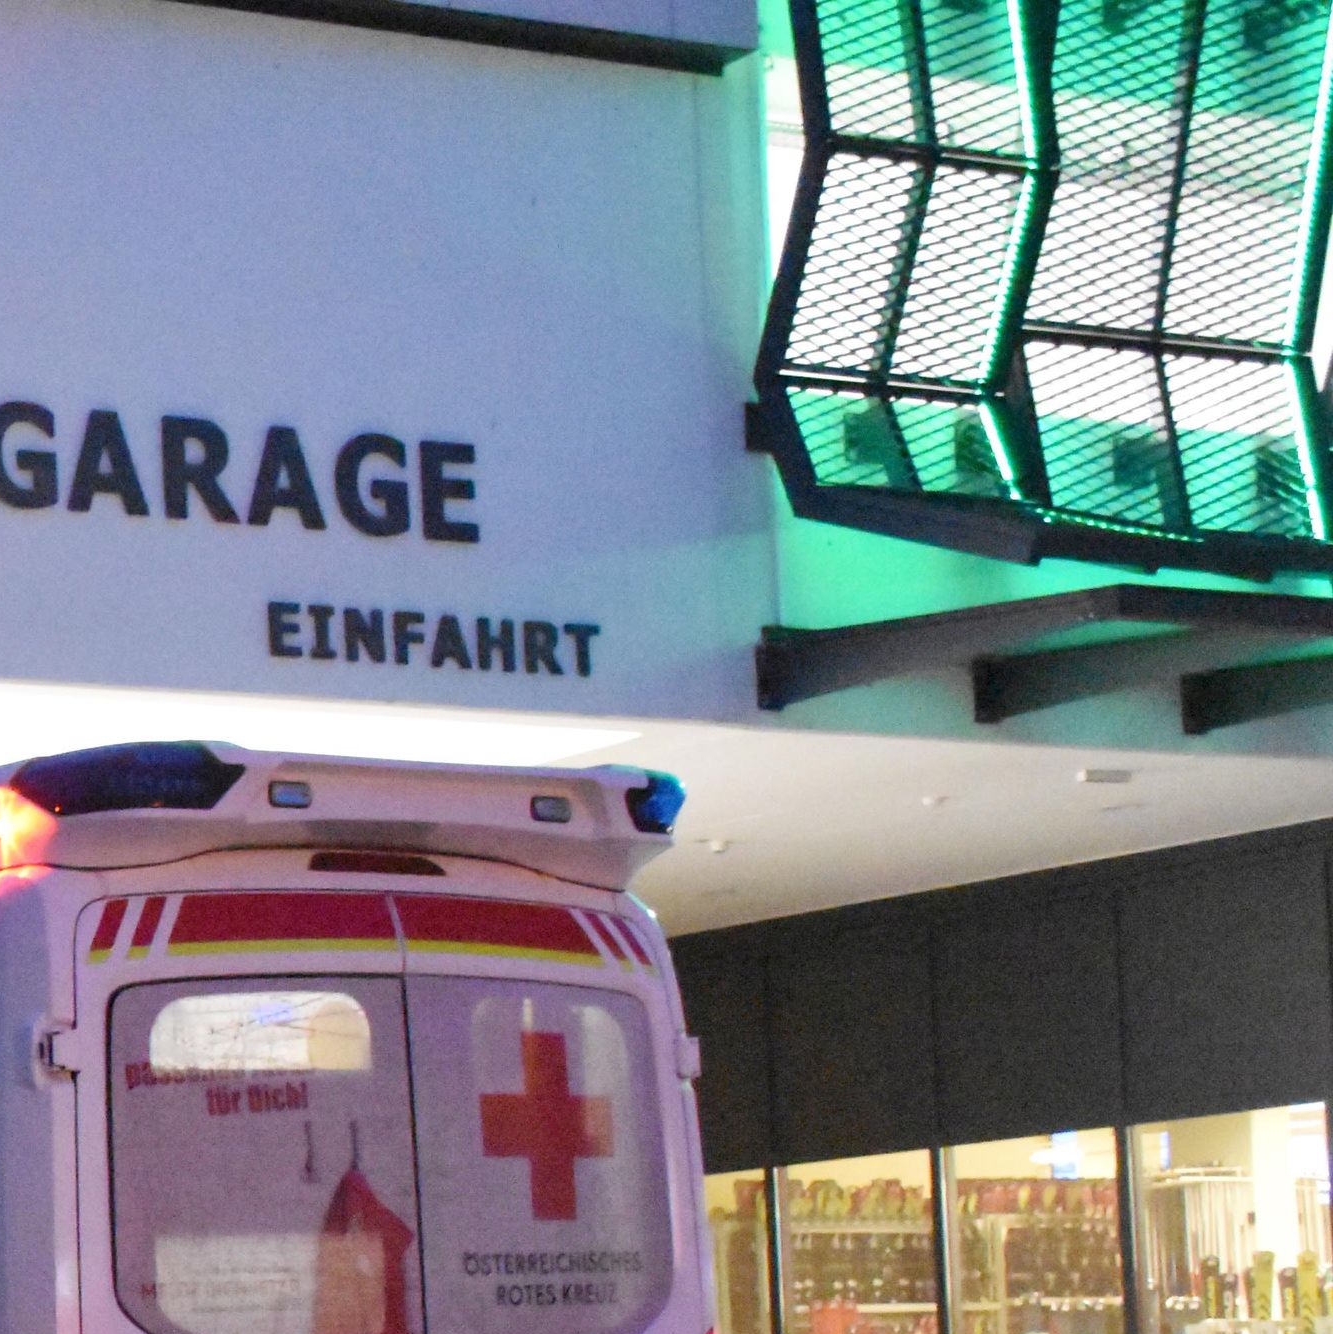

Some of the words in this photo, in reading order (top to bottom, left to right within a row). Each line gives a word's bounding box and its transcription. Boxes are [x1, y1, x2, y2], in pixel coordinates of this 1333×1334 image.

[265, 601, 601, 678] EINFAHRT
[463, 1252, 643, 1276] ÖSTERREICHISCHES
[496, 1284, 557, 1306] ROTES
[561, 1283, 616, 1304] KREUZ
